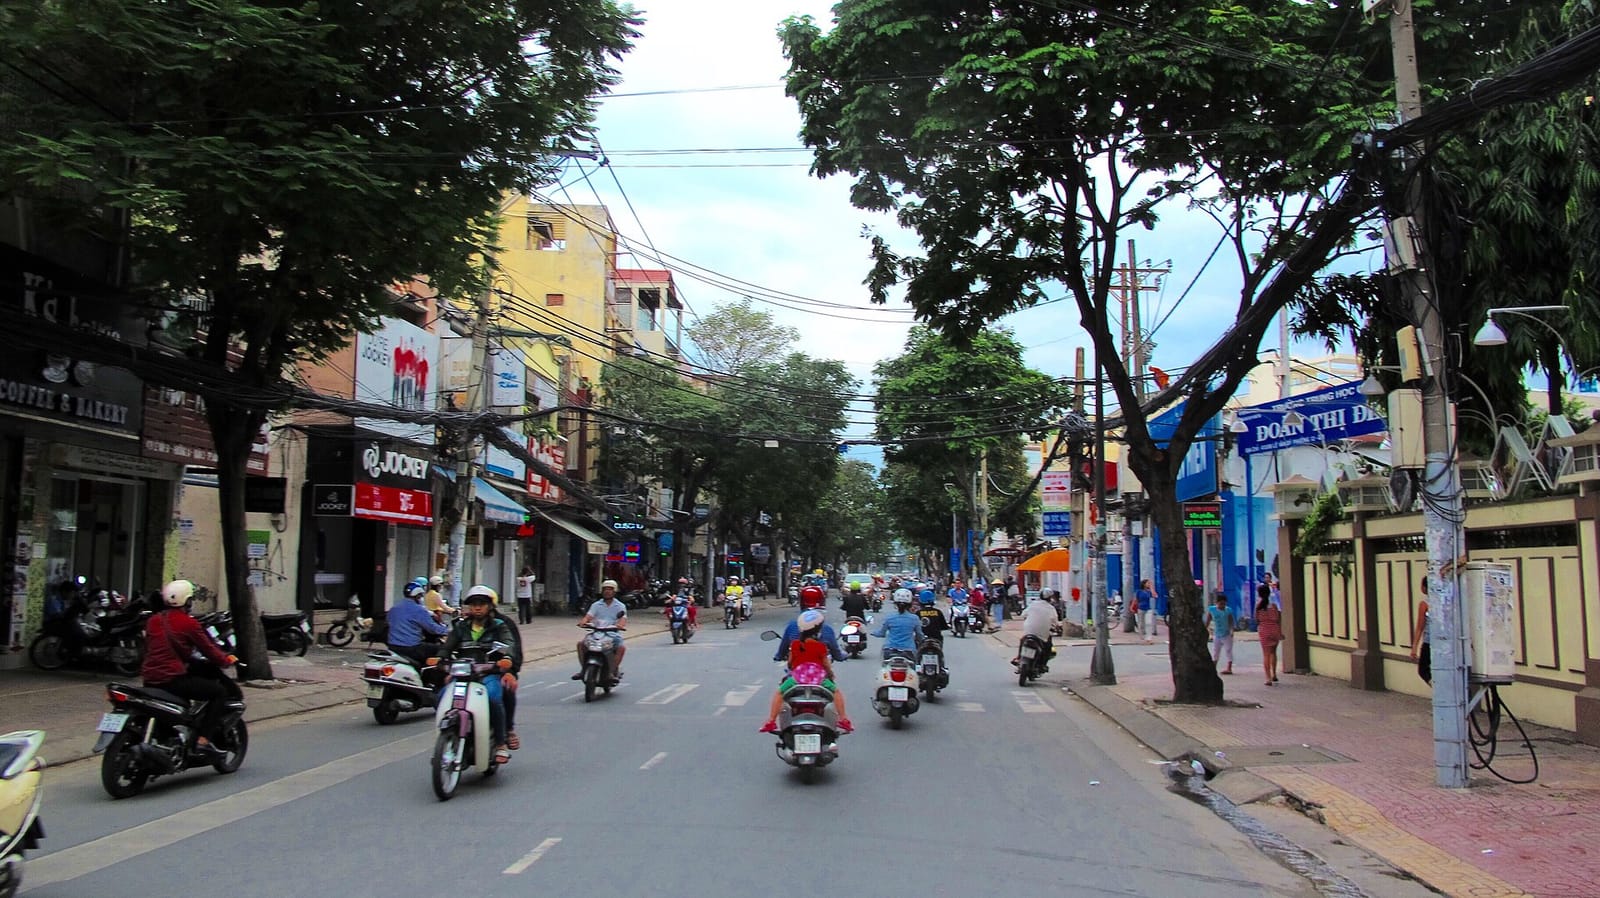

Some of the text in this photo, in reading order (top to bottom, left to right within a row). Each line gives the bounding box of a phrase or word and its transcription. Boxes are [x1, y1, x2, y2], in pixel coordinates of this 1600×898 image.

[0, 379, 55, 410] COFFEE
[61, 393, 71, 413] &
[76, 397, 128, 424] BAKERY
[1306, 392, 1335, 403] TRUNG
[1335, 386, 1356, 399] HỌC
[1310, 408, 1347, 431] THỊ
[379, 451, 429, 479] JOCKEY
[317, 502, 348, 510] JOCKEY
